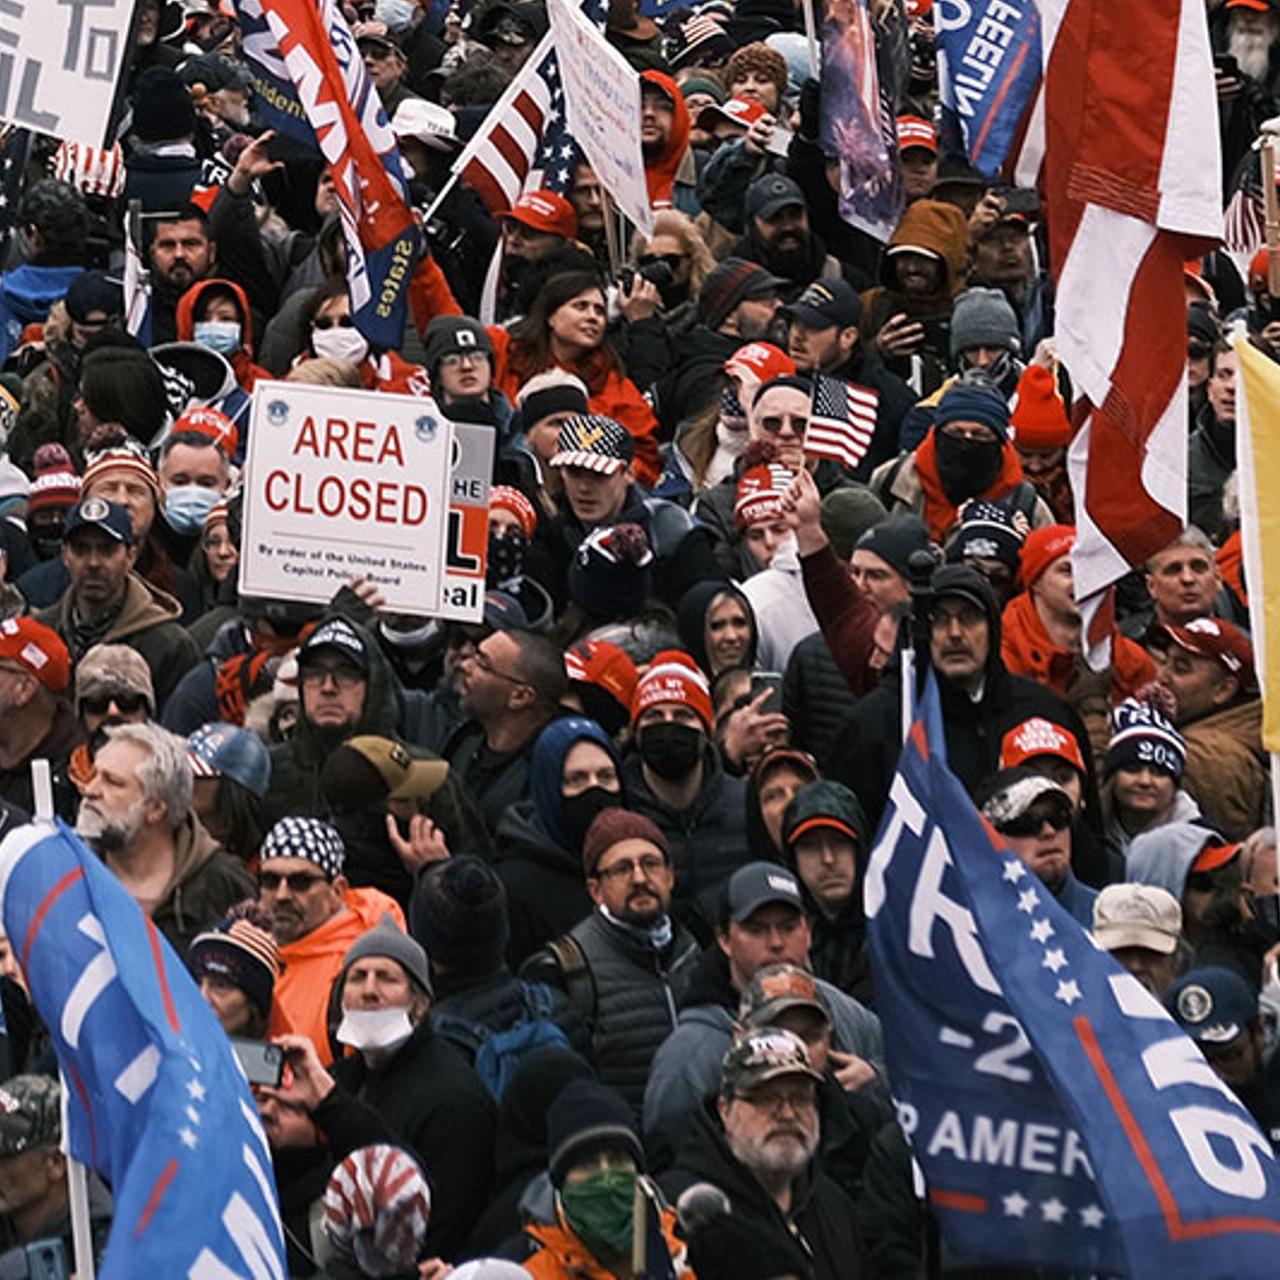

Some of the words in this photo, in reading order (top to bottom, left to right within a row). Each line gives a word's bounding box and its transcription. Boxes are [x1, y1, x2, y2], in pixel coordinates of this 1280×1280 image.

[293, 416, 406, 466] AREA
[265, 471, 428, 526] CLOSED
[454, 481, 481, 498] HE
[259, 544, 274, 558] By
[277, 547, 307, 561] order
[310, 548, 323, 560] of
[325, 550, 344, 563] the
[348, 553, 387, 567] United
[390, 558, 427, 572] States
[283, 563, 323, 578] Capitol
[326, 567, 362, 580] Polic
[926, 1111, 1095, 1178] AMER
